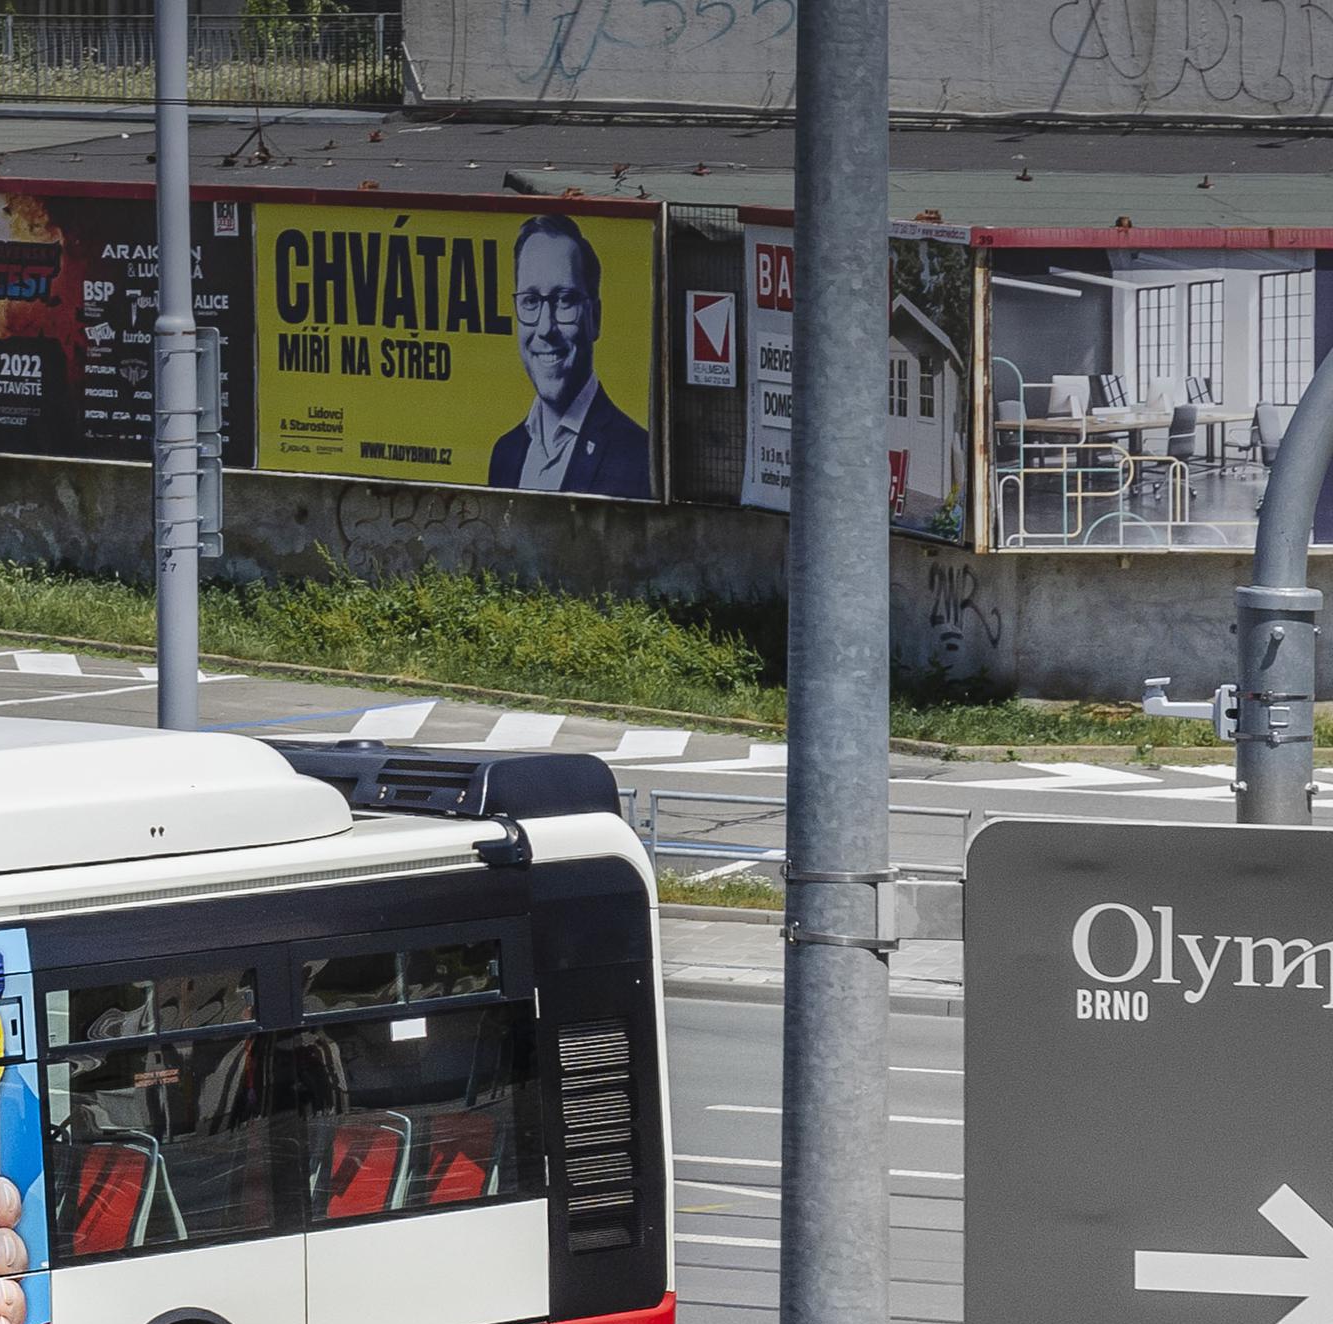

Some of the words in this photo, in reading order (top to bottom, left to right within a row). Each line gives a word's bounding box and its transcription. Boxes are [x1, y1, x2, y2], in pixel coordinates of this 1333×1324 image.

[275, 215, 513, 335] CHVÁTAL
[83, 280, 115, 301] BSP
[194, 295, 229, 310] ALICE
[123, 330, 151, 344] turbo
[278, 326, 330, 373] MÍŘÍ
[341, 335, 371, 376] NA
[380, 332, 451, 381] STŘED
[0, 353, 42, 377] 2022
[308, 407, 343, 420] Lidovci
[289, 419, 343, 433] Starostové
[360, 442, 452, 465] WWW.TADYBRNO.CZ
[1076, 988, 1149, 1022] BRNO
